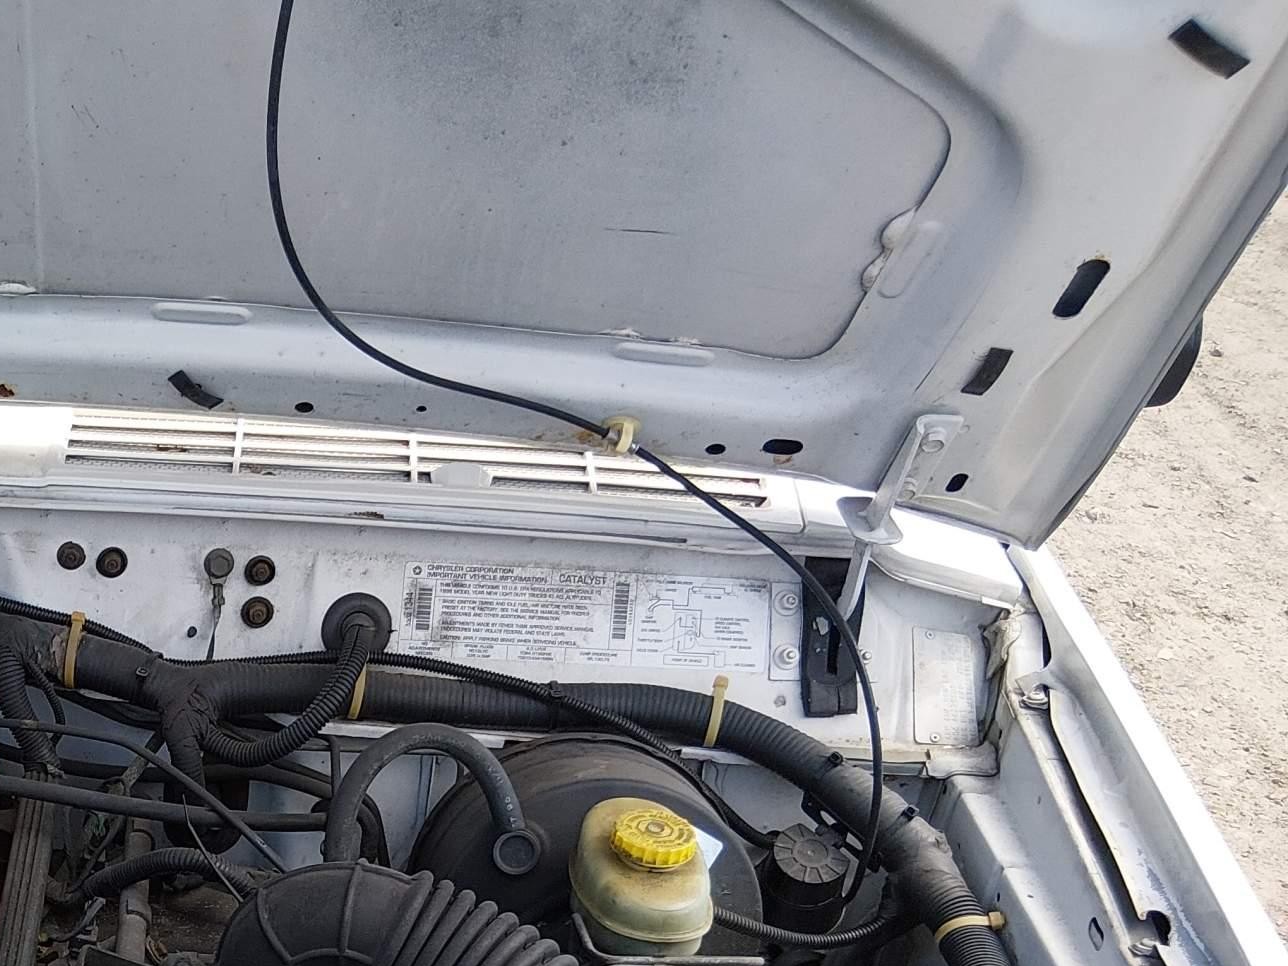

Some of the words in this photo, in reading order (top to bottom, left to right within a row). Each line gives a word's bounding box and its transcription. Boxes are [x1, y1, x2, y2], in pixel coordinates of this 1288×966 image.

[427, 564, 463, 572] CHRYSLER
[465, 566, 514, 575] CORPORATION
[499, 575, 547, 583] INFORMATION
[559, 574, 607, 585] CATALYST
